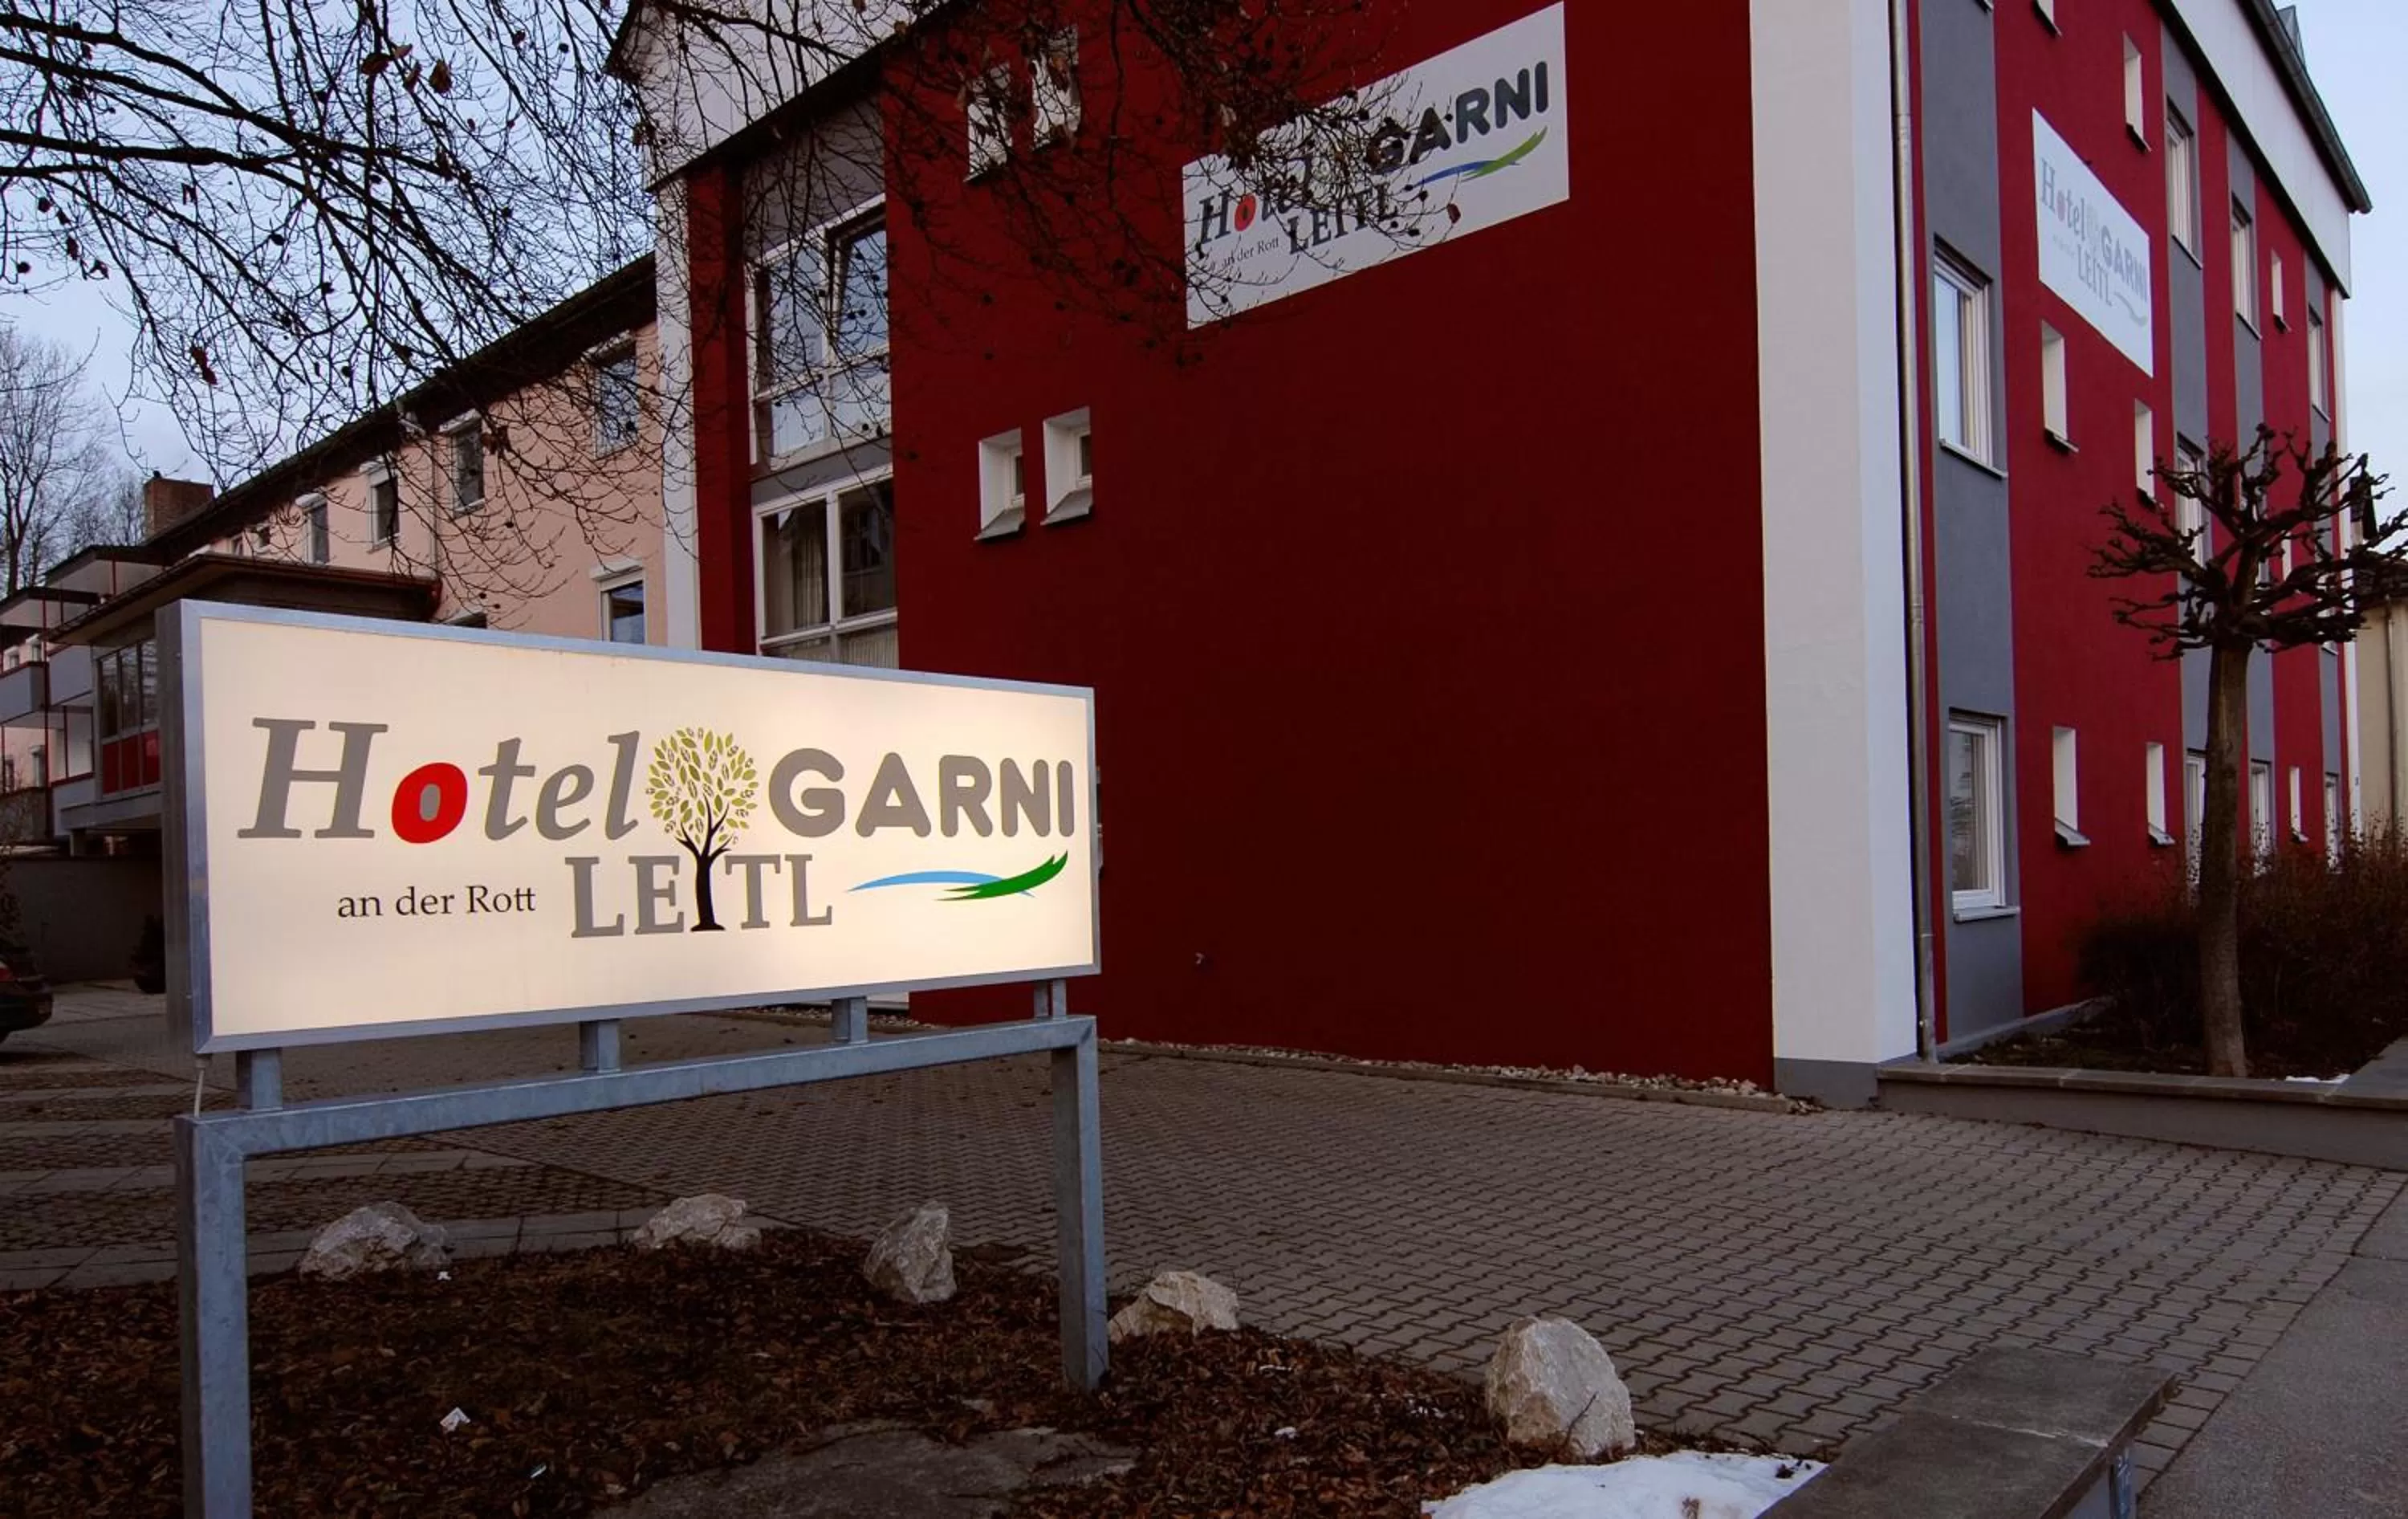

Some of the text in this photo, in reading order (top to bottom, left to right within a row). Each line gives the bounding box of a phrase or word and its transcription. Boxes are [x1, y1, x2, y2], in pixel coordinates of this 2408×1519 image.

[1366, 60, 1548, 176] GARNI
[1237, 247, 1254, 262] der
[2040, 157, 2086, 242] Hotel
[2101, 225, 2148, 303] GARNI
[2076, 243, 2113, 307] LEITL
[238, 717, 1075, 845] Hotel GARNI
[337, 884, 536, 918] an der Rott
[564, 853, 832, 939] LEITL
